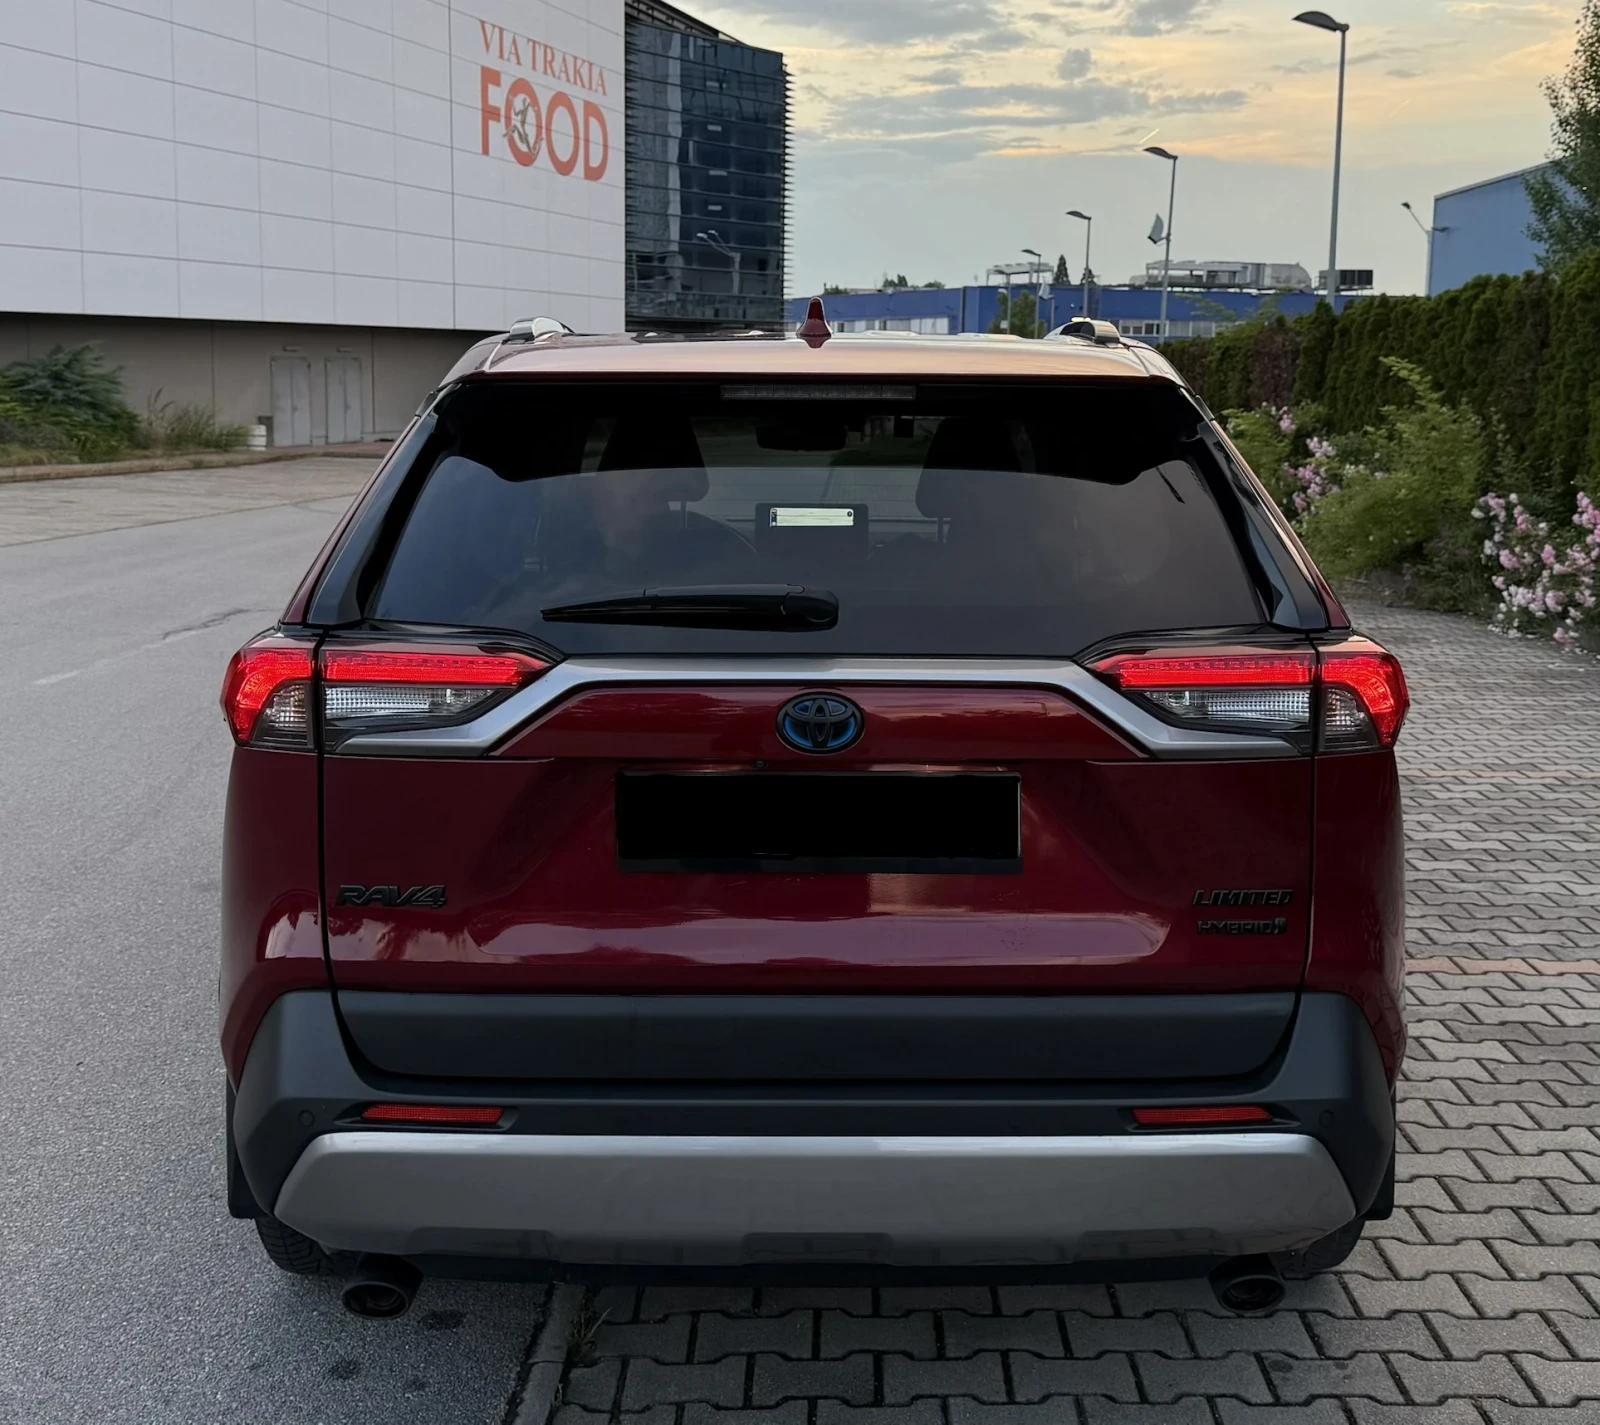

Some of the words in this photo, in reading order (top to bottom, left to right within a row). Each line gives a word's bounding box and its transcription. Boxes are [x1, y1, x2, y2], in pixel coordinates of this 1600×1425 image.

[479, 20, 523, 66] VIA
[527, 38, 607, 96] TRAKIA
[481, 65, 609, 182] FOOD
[337, 884, 447, 907] RAV4
[1193, 889, 1293, 906] LIMITED
[1197, 920, 1274, 934] HYBRID
